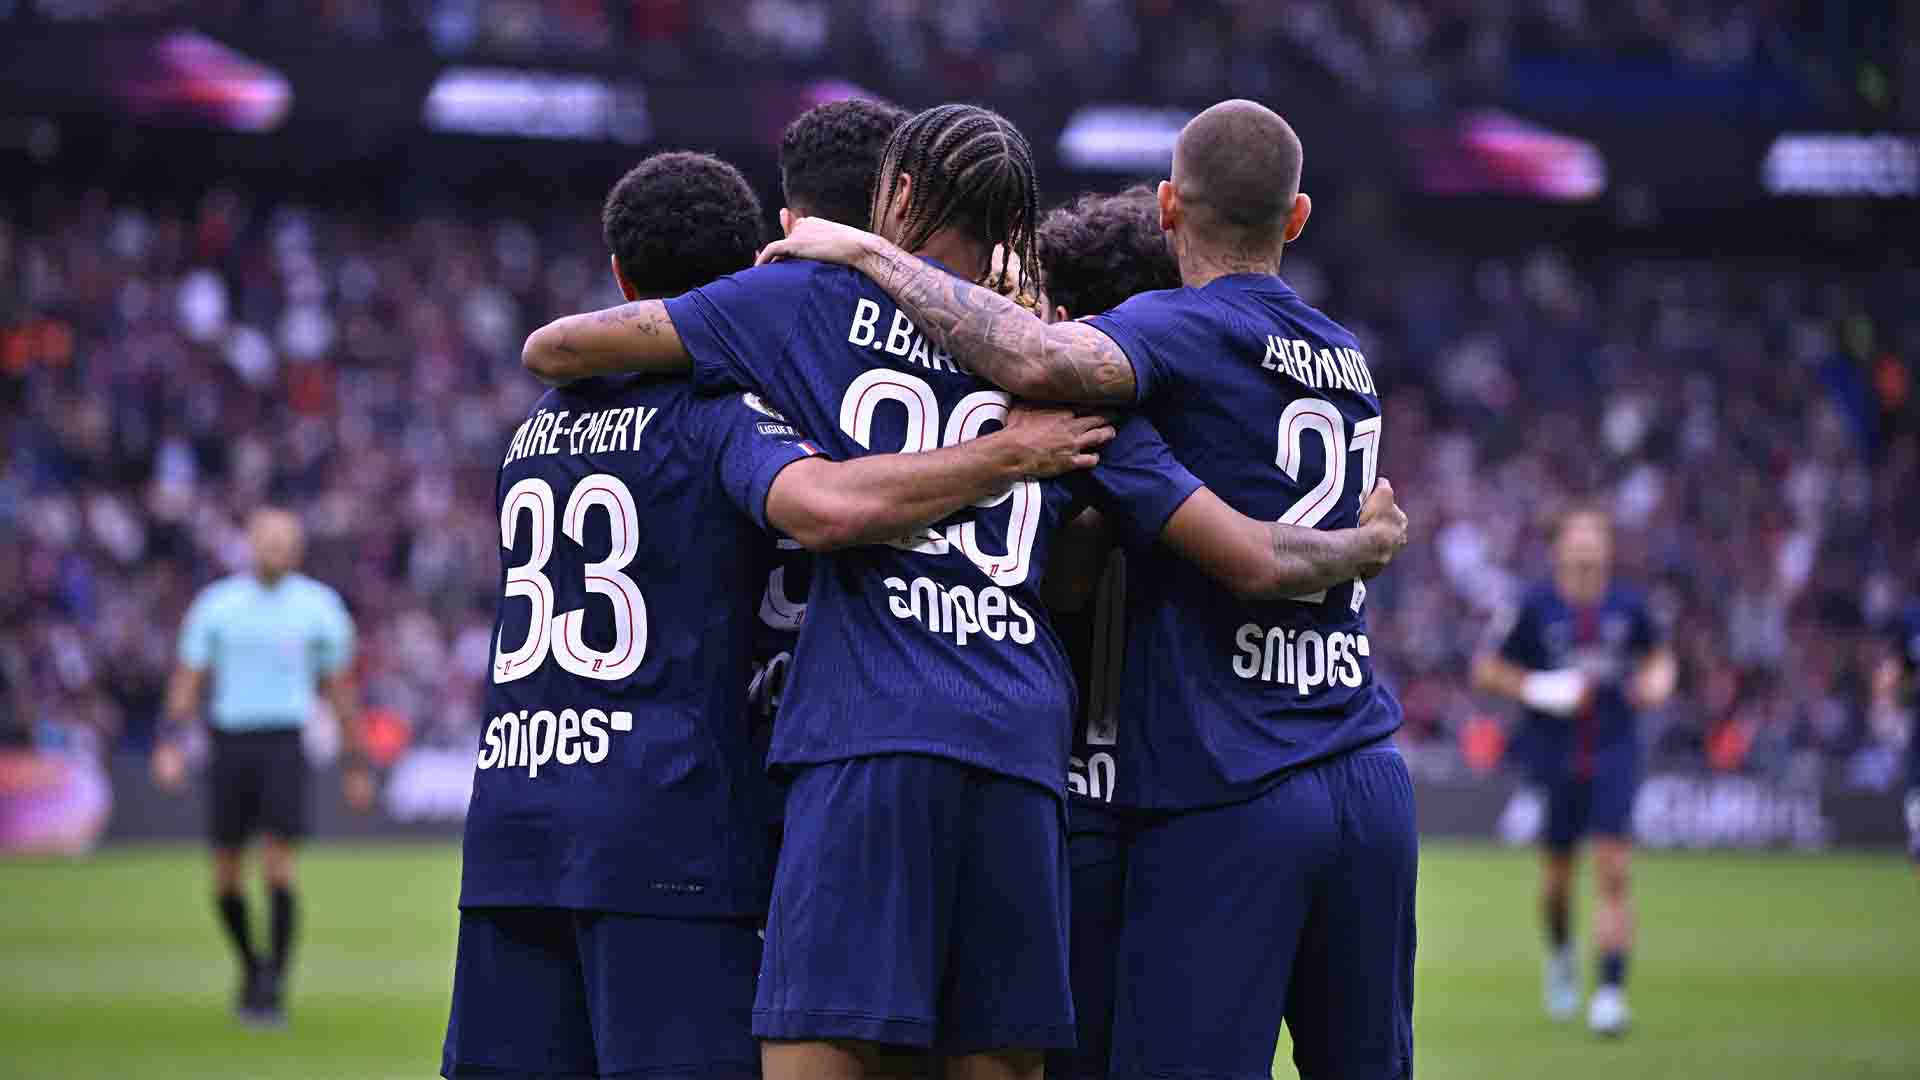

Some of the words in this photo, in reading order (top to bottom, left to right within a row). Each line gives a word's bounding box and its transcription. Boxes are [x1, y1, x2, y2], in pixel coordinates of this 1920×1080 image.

[848, 298, 974, 376] B.BAR
[1261, 335, 1377, 397] L.HERNAND
[1275, 398, 1382, 613] 21
[494, 474, 648, 684] 33
[883, 577, 1036, 646] snipes
[1233, 623, 1363, 695] snipes
[476, 708, 609, 778] snipes
